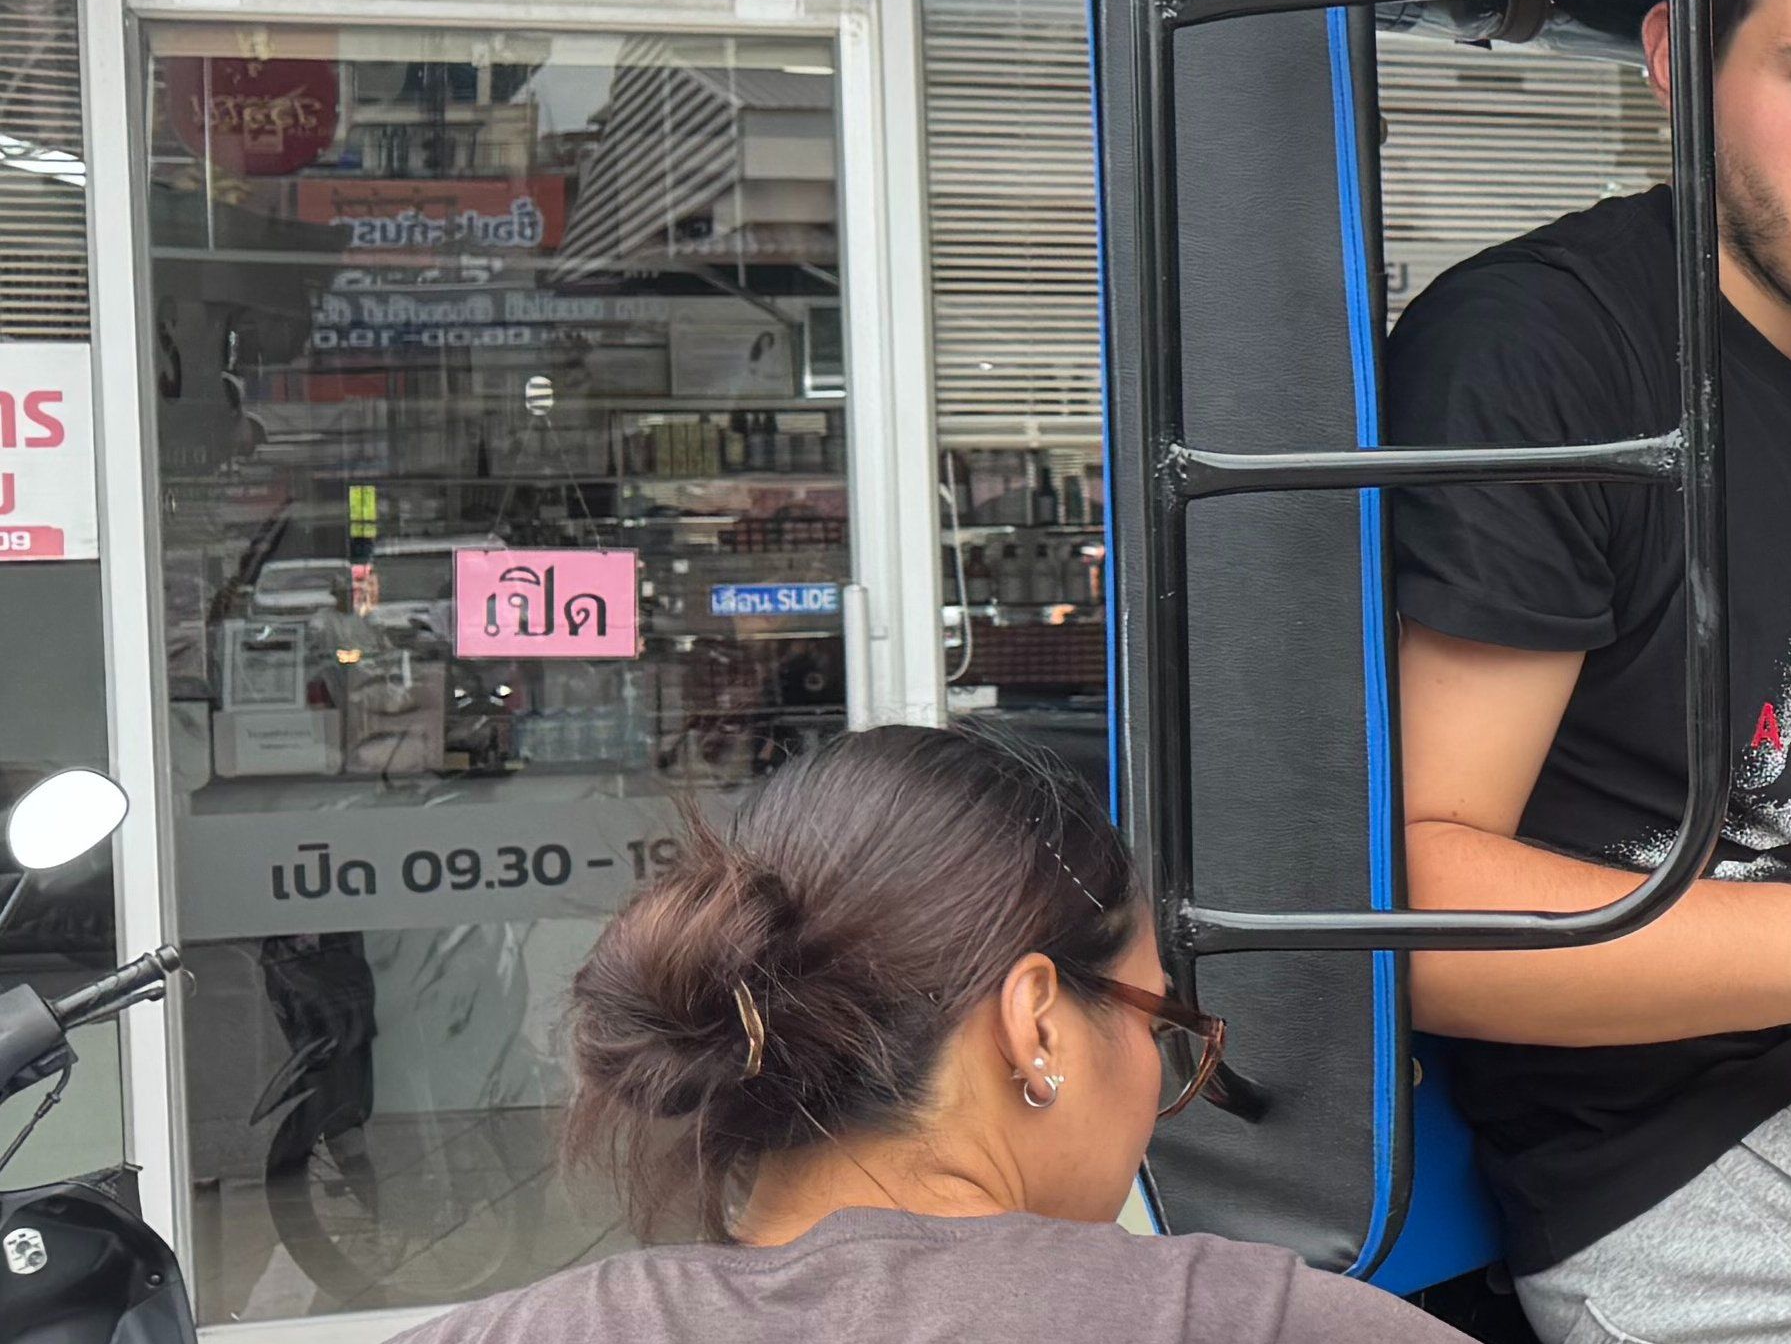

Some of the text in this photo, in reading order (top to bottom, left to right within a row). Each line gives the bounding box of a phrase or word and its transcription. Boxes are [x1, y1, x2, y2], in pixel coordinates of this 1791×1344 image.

[484, 565, 608, 637] เปิด
[777, 588, 838, 612] SLIDE
[271, 843, 377, 900] เปิด
[402, 843, 573, 894] 09.30
[627, 838, 682, 880] 19
